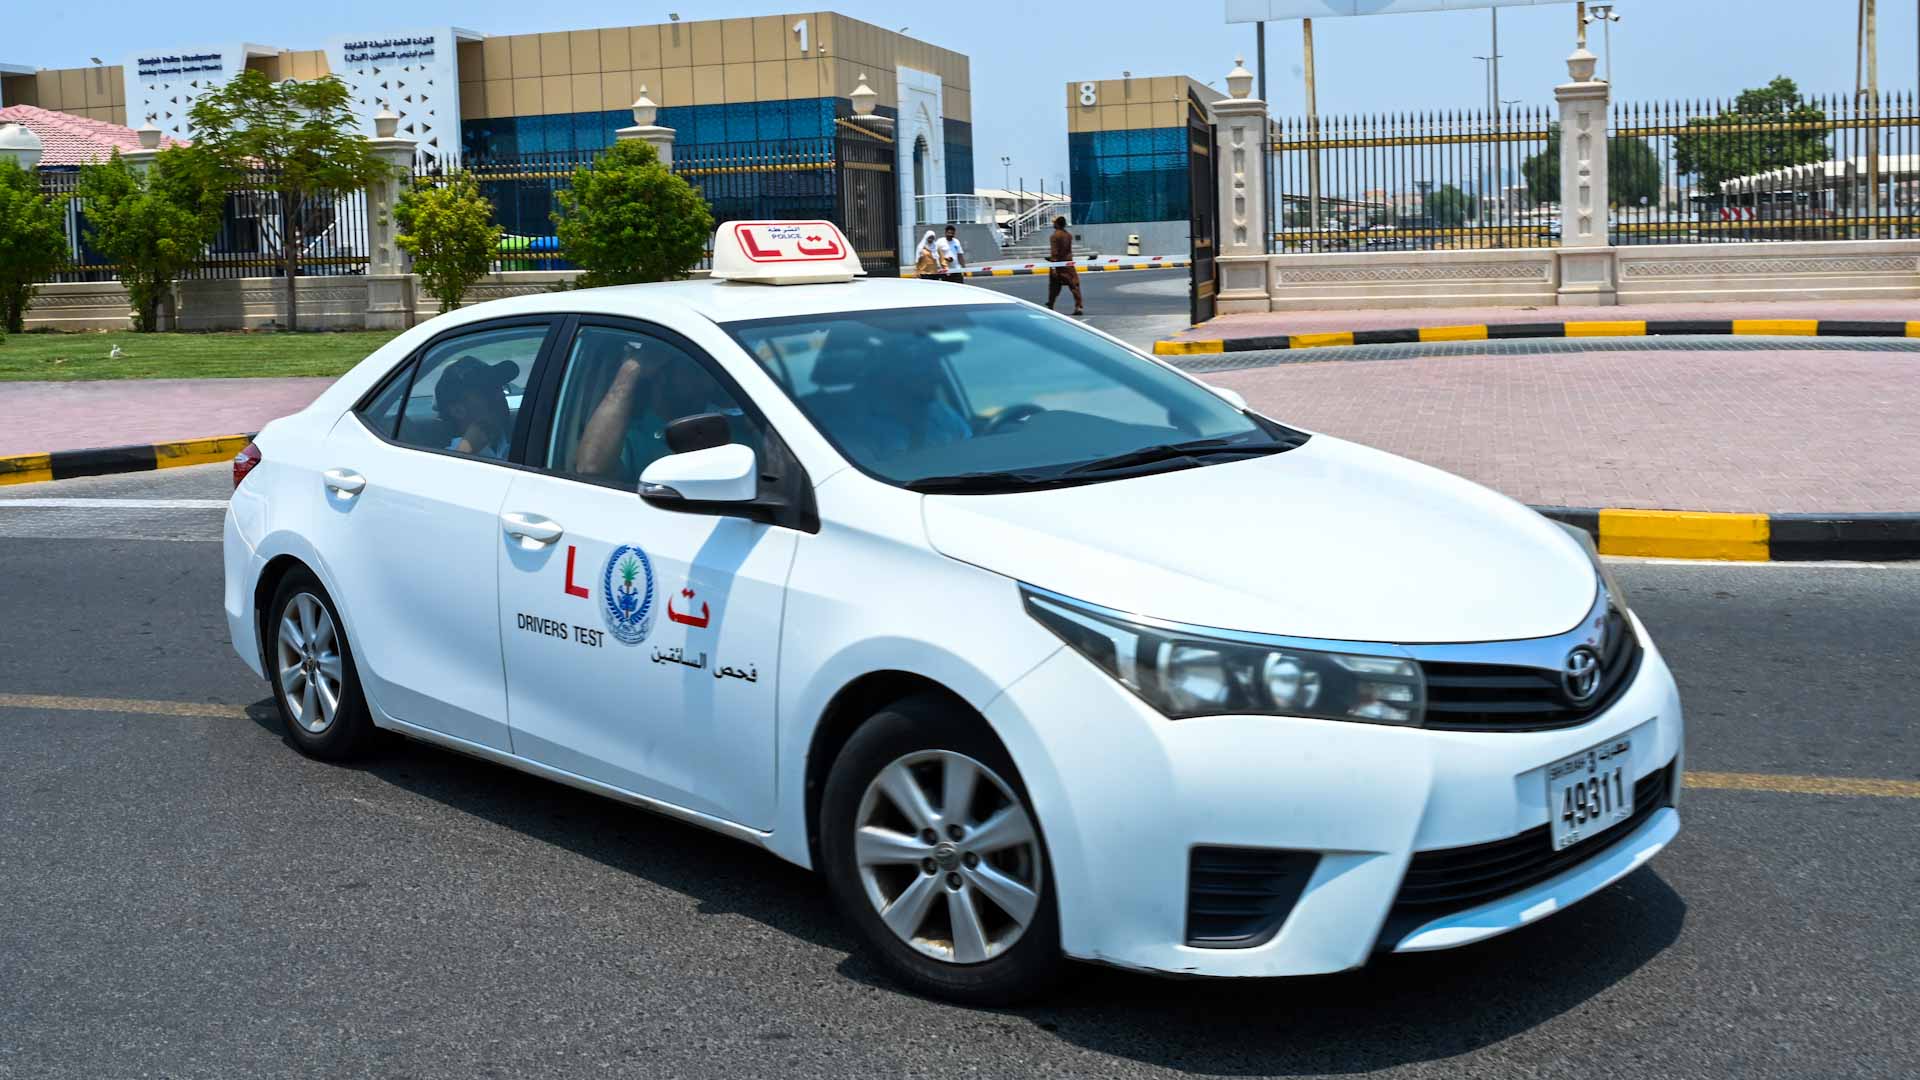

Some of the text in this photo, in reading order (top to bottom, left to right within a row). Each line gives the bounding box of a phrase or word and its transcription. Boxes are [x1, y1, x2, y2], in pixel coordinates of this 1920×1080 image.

[791, 18, 809, 52] 1
[1079, 82, 1097, 106] 8
[740, 229, 783, 257] L
[797, 235, 840, 256] ت
[564, 545, 589, 600] L
[667, 587, 710, 629] ت
[516, 612, 569, 640] DRIVERS
[572, 625, 605, 648] TEST
[650, 645, 758, 683] فحص السائقين
[1562, 766, 1625, 829] 49311
